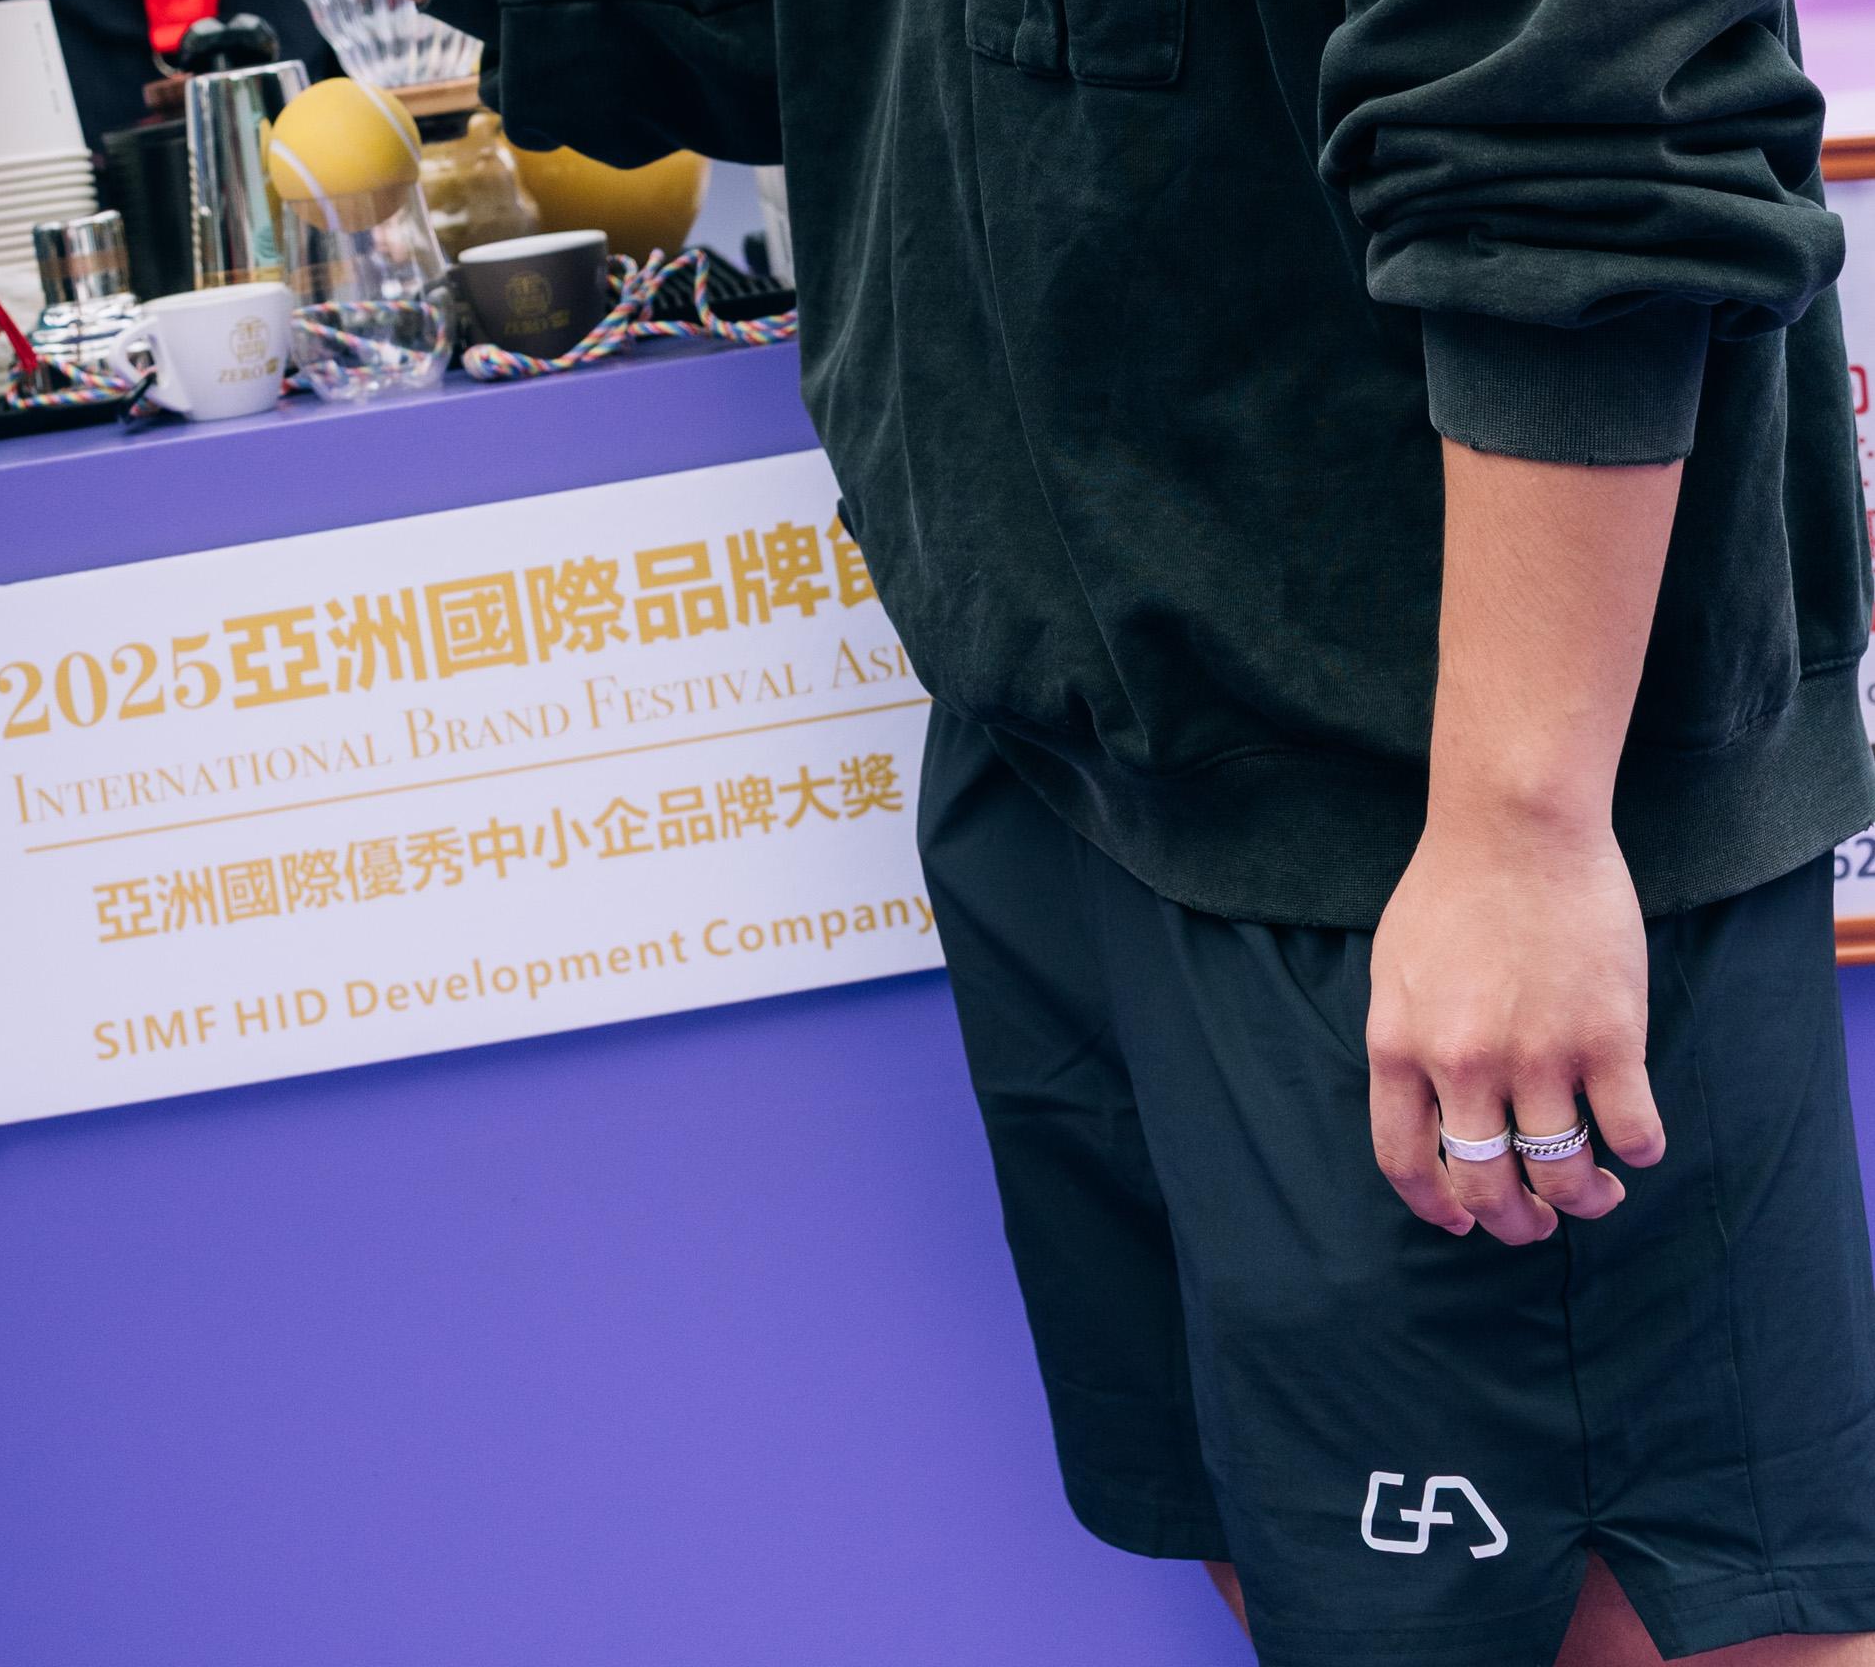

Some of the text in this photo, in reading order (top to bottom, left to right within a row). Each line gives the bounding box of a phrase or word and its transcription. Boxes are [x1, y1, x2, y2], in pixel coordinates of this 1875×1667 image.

[13, 733, 392, 824] INTERNATIONAL
[406, 705, 571, 759] BRAND
[584, 661, 813, 731] FESTIVAL
[93, 895, 935, 1061] SIMF HID Development Company
